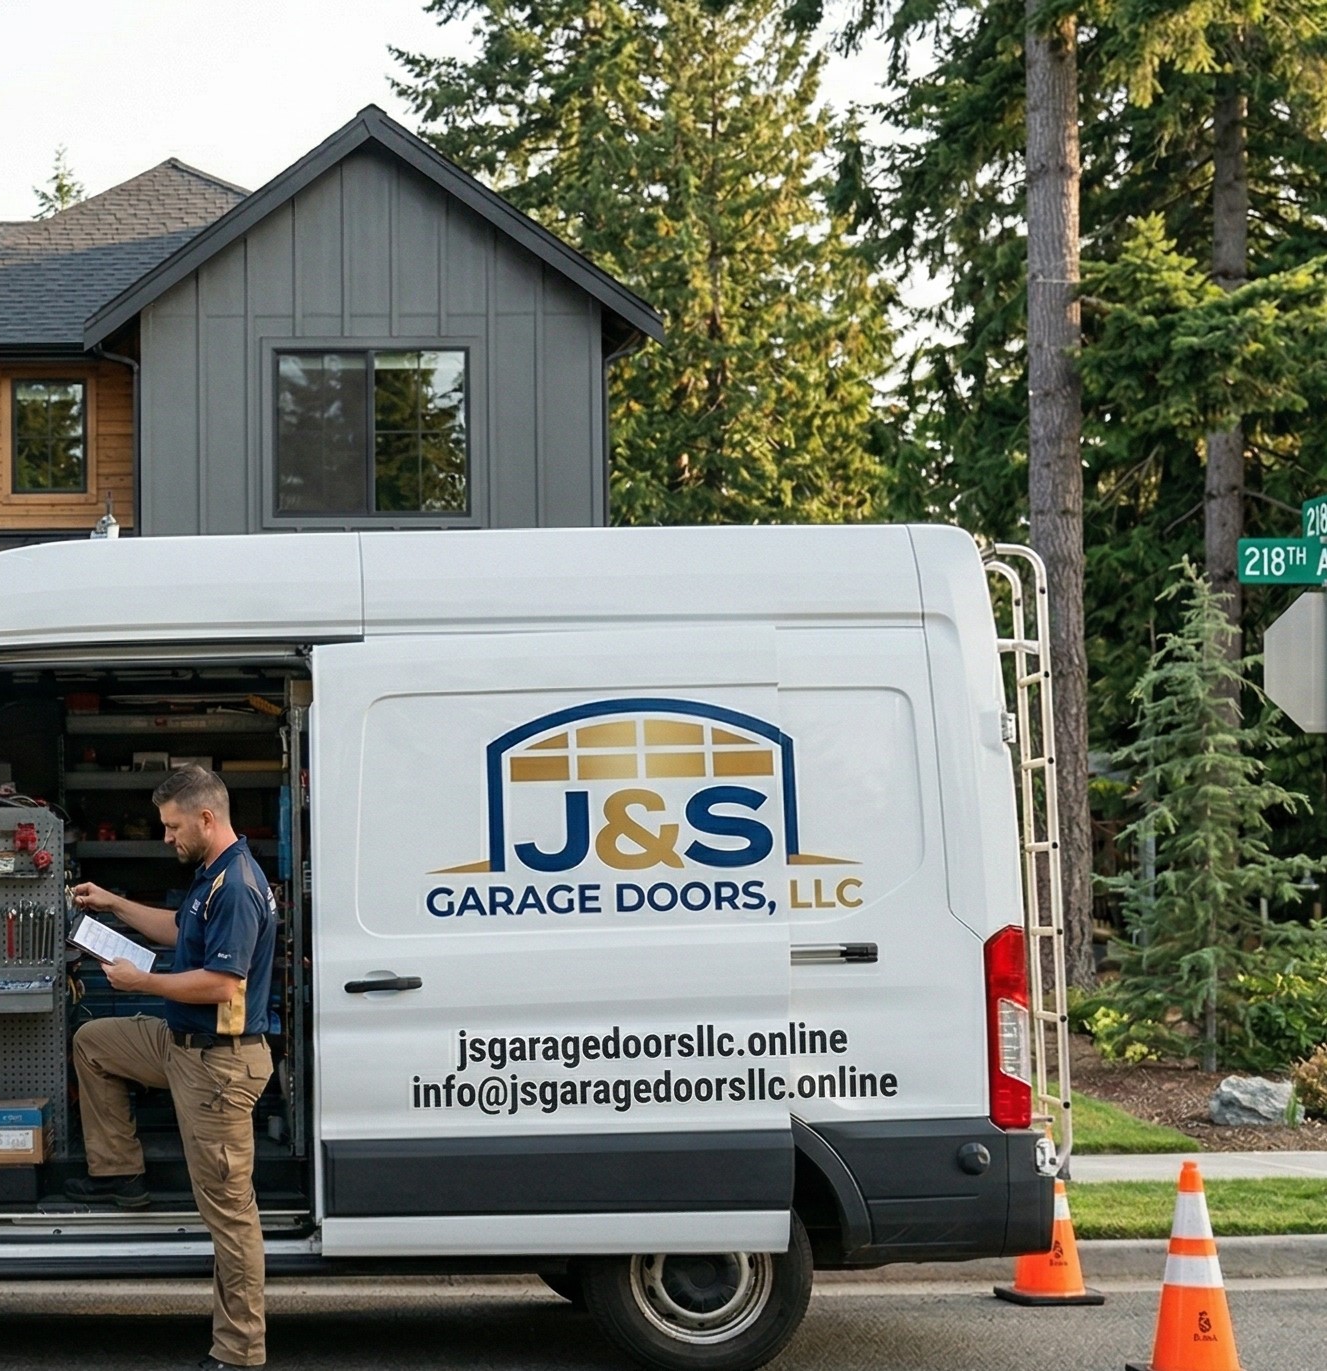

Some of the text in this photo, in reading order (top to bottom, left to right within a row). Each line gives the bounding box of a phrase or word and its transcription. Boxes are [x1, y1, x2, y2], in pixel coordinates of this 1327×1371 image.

[1244, 546, 1307, 576] 218TH
[513, 785, 774, 873] J&S
[426, 878, 864, 918] GARAGE DOORS, LLC
[456, 1021, 848, 1072] jsgaragedoorsllc.online
[413, 1065, 899, 1115] info@jsgaragedoorsllc.online
